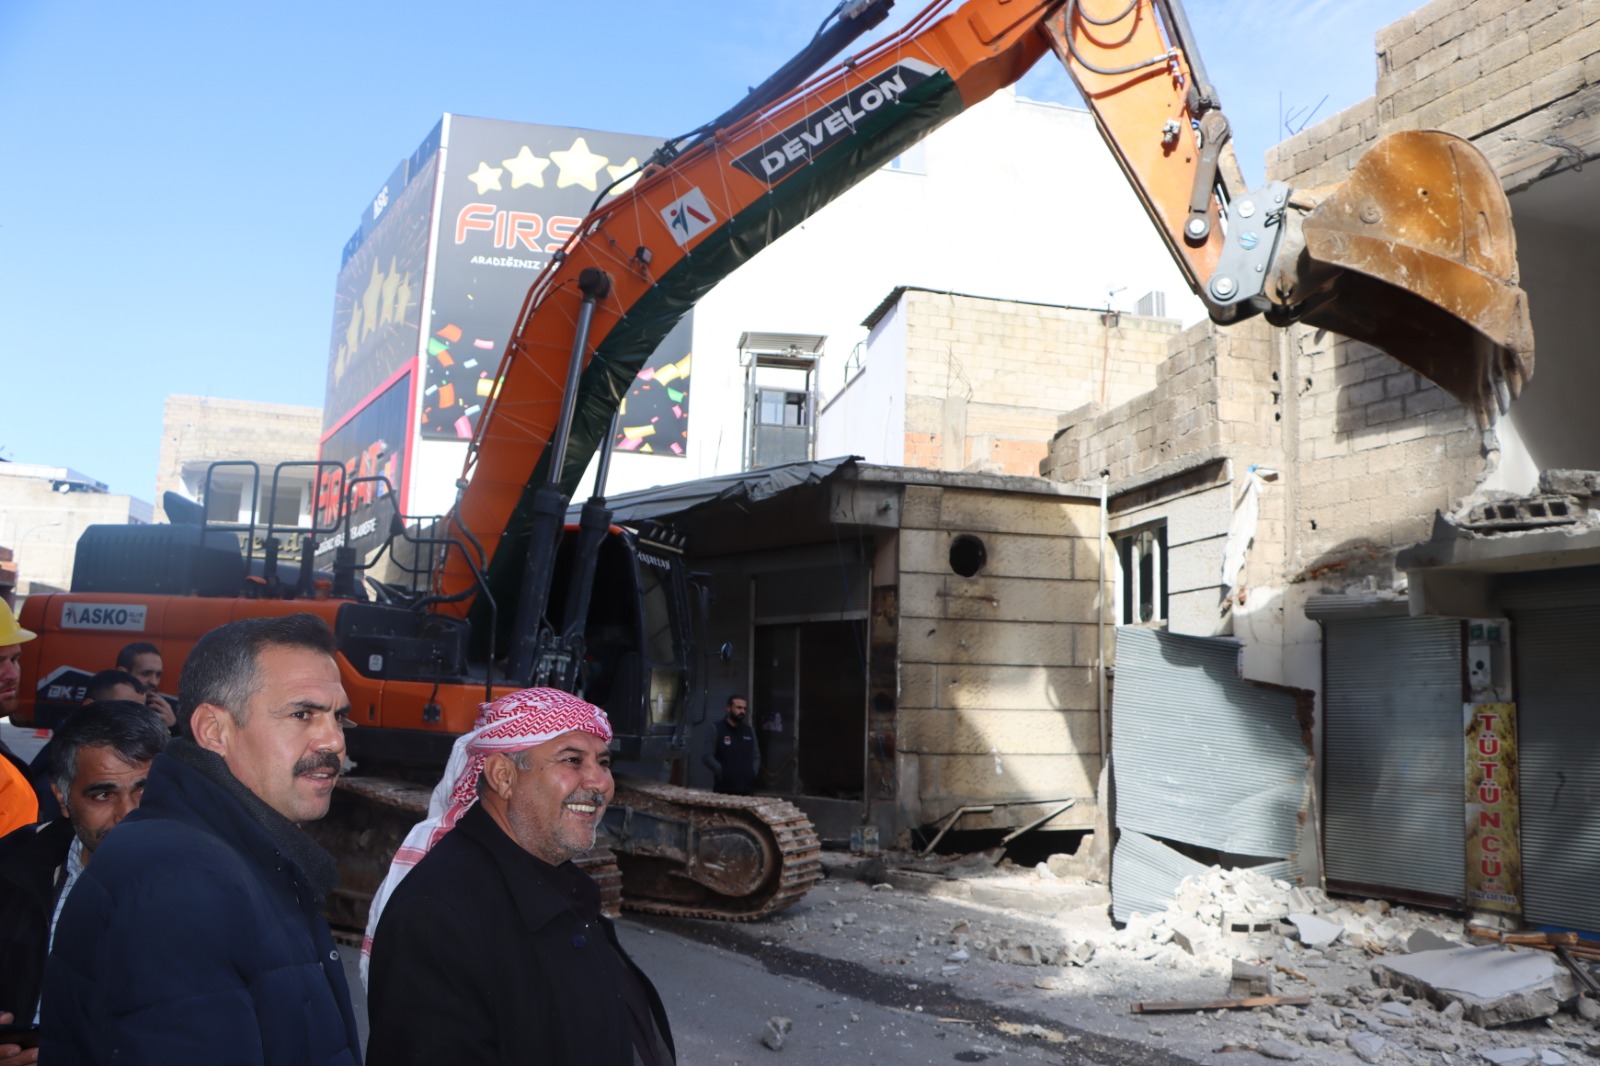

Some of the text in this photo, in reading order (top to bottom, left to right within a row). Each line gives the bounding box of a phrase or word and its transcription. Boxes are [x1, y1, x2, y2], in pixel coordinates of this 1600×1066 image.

[760, 73, 907, 176] DEVELON
[79, 607, 128, 625] ASKO
[1477, 713, 1503, 878] TÜTÜNCÜ
